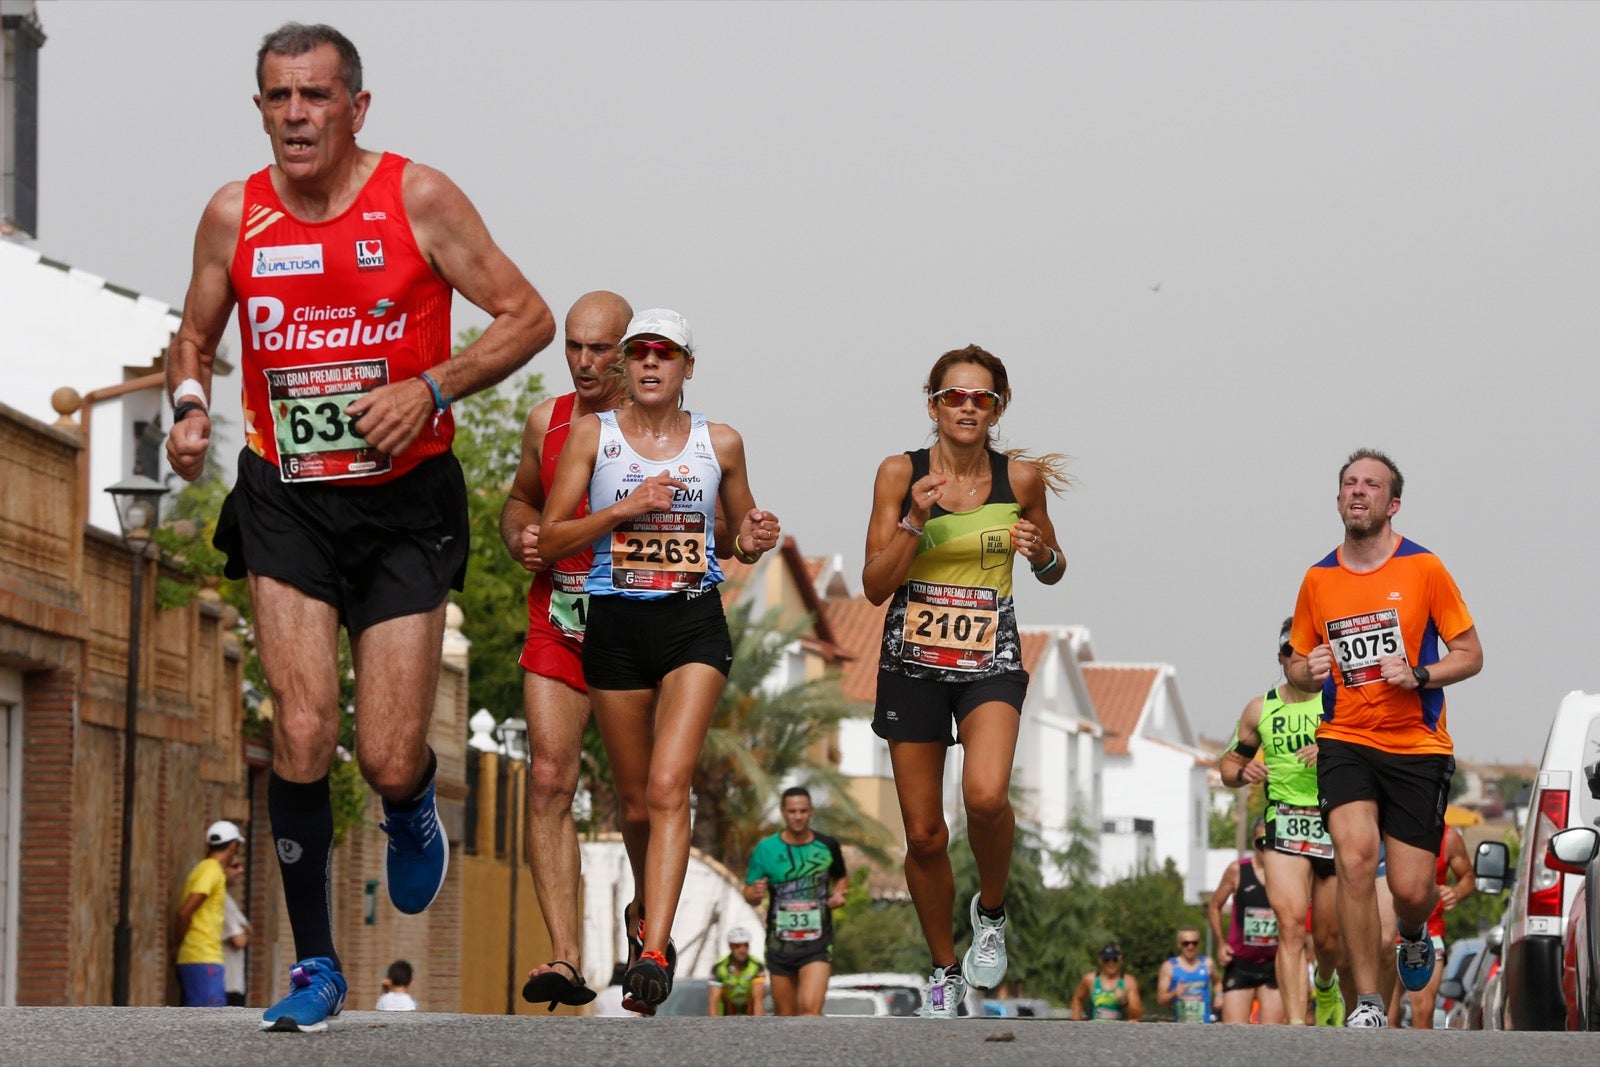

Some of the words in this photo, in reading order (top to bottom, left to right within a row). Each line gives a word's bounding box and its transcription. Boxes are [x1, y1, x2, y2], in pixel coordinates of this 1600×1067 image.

[358, 256, 384, 266] MOVE
[247, 296, 408, 351] Polisalud
[293, 305, 356, 322] Clínicas
[287, 372, 309, 387] GRAN
[309, 368, 341, 384] PREMIO
[342, 367, 353, 380] DE
[355, 364, 382, 380] FONDO
[615, 489, 703, 502] MENA
[652, 512, 674, 523] PREMIO
[675, 513, 682, 523] DE
[625, 538, 701, 564] 2263
[926, 585, 943, 597] GRAN
[943, 586, 966, 599] PREMIO
[966, 589, 973, 599] DE
[974, 589, 993, 601] FONDO
[915, 610, 992, 643] 2107
[1339, 632, 1398, 663] 3075
[1272, 714, 1319, 735] RUN
[1286, 818, 1325, 839] 883
[790, 913, 809, 928] 33
